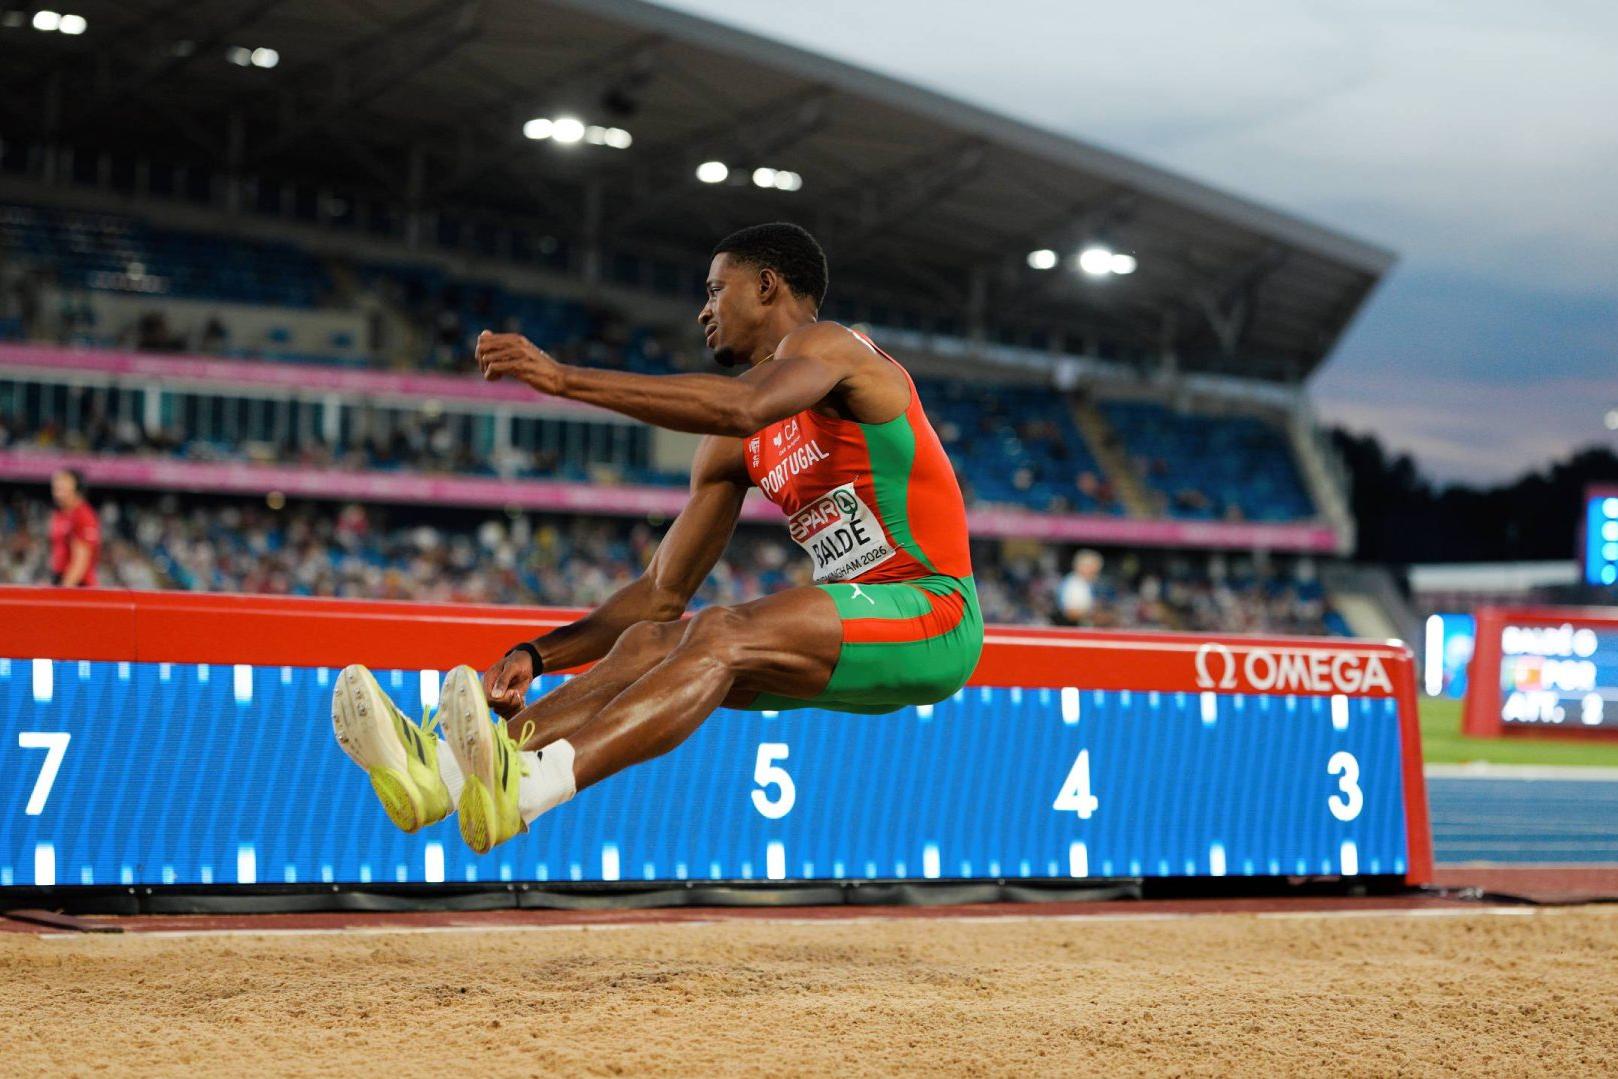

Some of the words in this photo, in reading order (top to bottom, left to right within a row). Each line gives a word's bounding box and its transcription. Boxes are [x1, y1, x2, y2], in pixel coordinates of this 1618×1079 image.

[761, 440, 830, 499] PORTUGAL
[790, 500, 838, 539] SPAR
[812, 512, 871, 568] BALDÉ
[816, 559, 863, 584] MINGHAM
[861, 546, 887, 566] 2026
[1244, 649, 1394, 693] OMEGA
[19, 732, 71, 815] 7
[751, 743, 796, 819] 5
[1053, 748, 1098, 819] 4
[1327, 751, 1363, 821] 3
